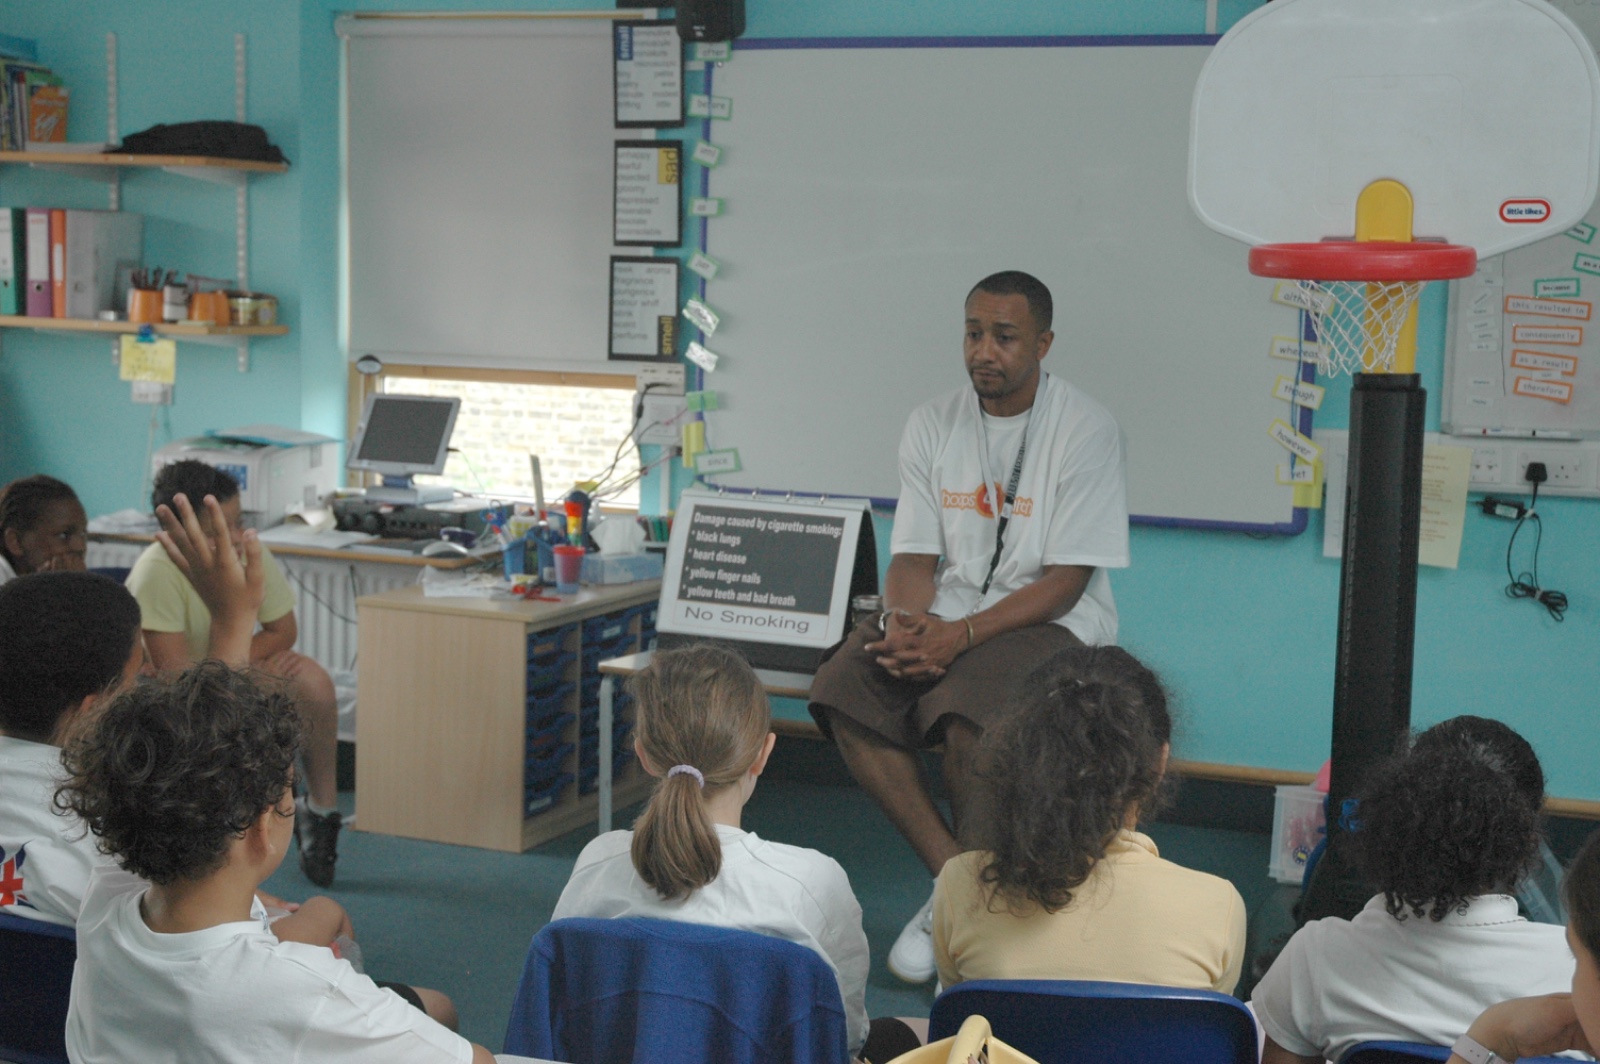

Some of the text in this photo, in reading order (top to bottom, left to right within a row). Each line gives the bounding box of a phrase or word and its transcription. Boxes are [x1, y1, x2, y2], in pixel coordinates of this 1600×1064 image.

[619, 25, 630, 59] small
[702, 47, 725, 57] after
[697, 99, 726, 110] beore
[664, 147, 678, 184] sad
[1511, 301, 1585, 315] this resulted in
[661, 316, 674, 355] smell
[1520, 331, 1576, 341] consequently
[1518, 356, 1569, 369] as a result
[1523, 383, 1564, 396] therefore
[1276, 430, 1312, 455] however
[942, 491, 977, 509] hoops
[694, 512, 842, 539] Damage caused by cigarette smoking:
[696, 530, 742, 547] black lungs
[692, 548, 747, 565] heart disease
[689, 567, 761, 585] yellow finger nails
[687, 585, 797, 607] yellow teeth and bad breath
[684, 606, 811, 634] No Smoking
